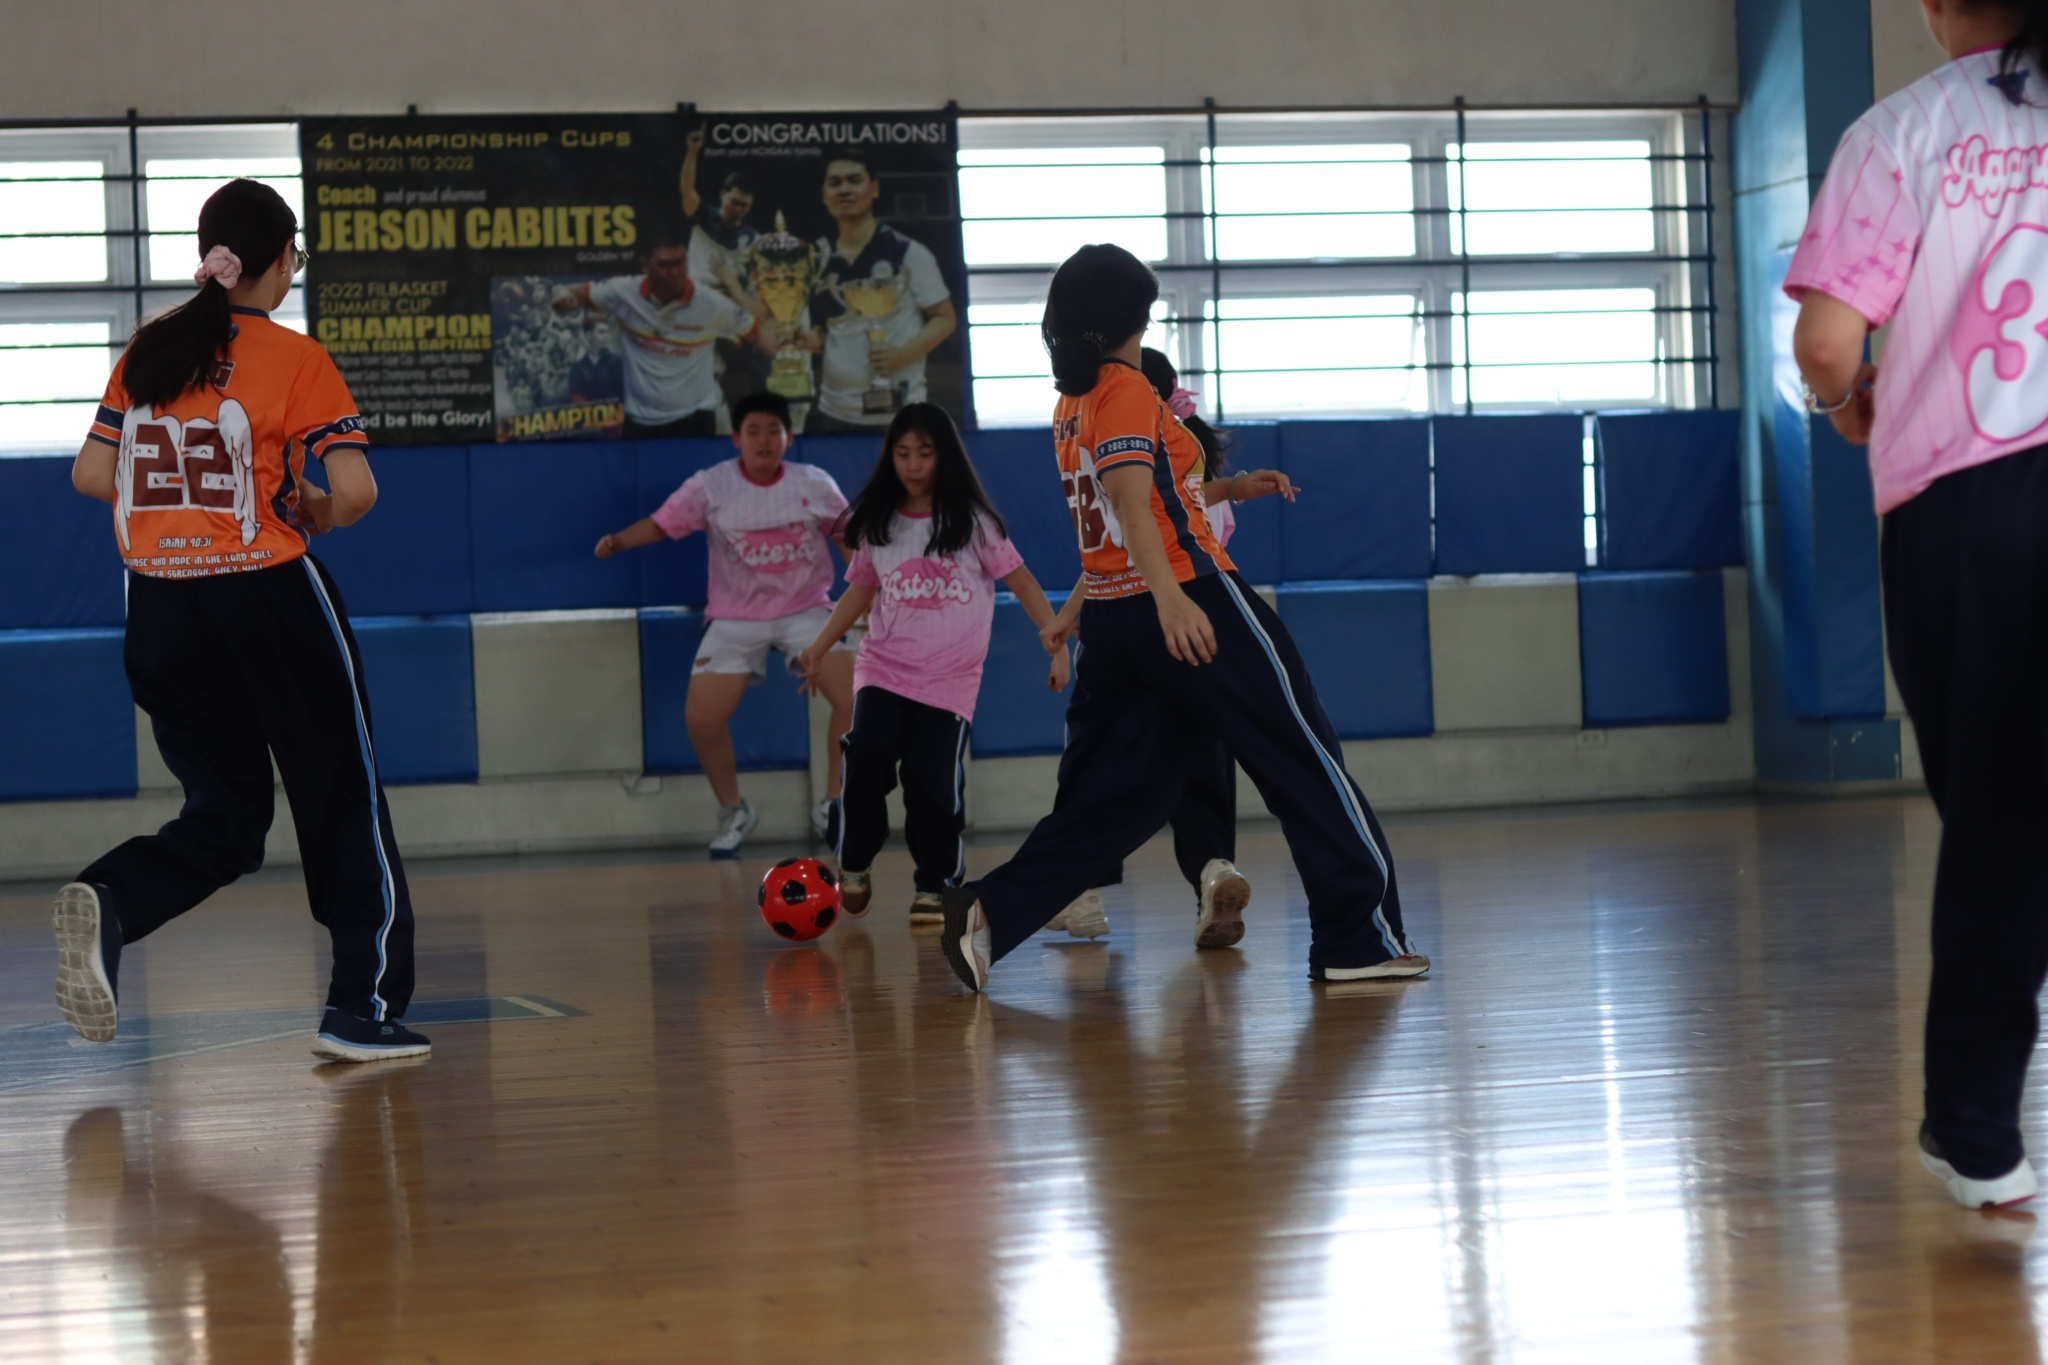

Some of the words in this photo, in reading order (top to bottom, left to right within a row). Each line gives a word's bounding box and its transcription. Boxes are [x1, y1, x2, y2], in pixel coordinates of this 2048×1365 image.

[316, 133, 334, 150] 4
[711, 123, 946, 145] CONGRATULATIONS!
[316, 156, 362, 171] FROM
[366, 156, 404, 171] 2021
[409, 155, 430, 170] TO
[434, 155, 474, 170] 2022
[317, 184, 377, 206] Coach
[383, 187, 404, 203] and
[316, 208, 456, 252] JERSON
[465, 204, 637, 249] CABILTES
[318, 282, 363, 299] 2022
[367, 280, 447, 298] FILBASKET
[318, 299, 390, 315] SUMMER
[395, 298, 432, 314] CUP
[316, 314, 492, 340] CHAMPION
[384, 412, 407, 428] be
[410, 411, 438, 428] the
[442, 410, 492, 430] Glory!
[1107, 439, 1150, 453] 2025-2026
[131, 422, 237, 510] 22
[151, 556, 167, 567] WHO
[169, 556, 191, 567] HOPE
[225, 551, 248, 563] LORD
[881, 570, 973, 606] Astera
